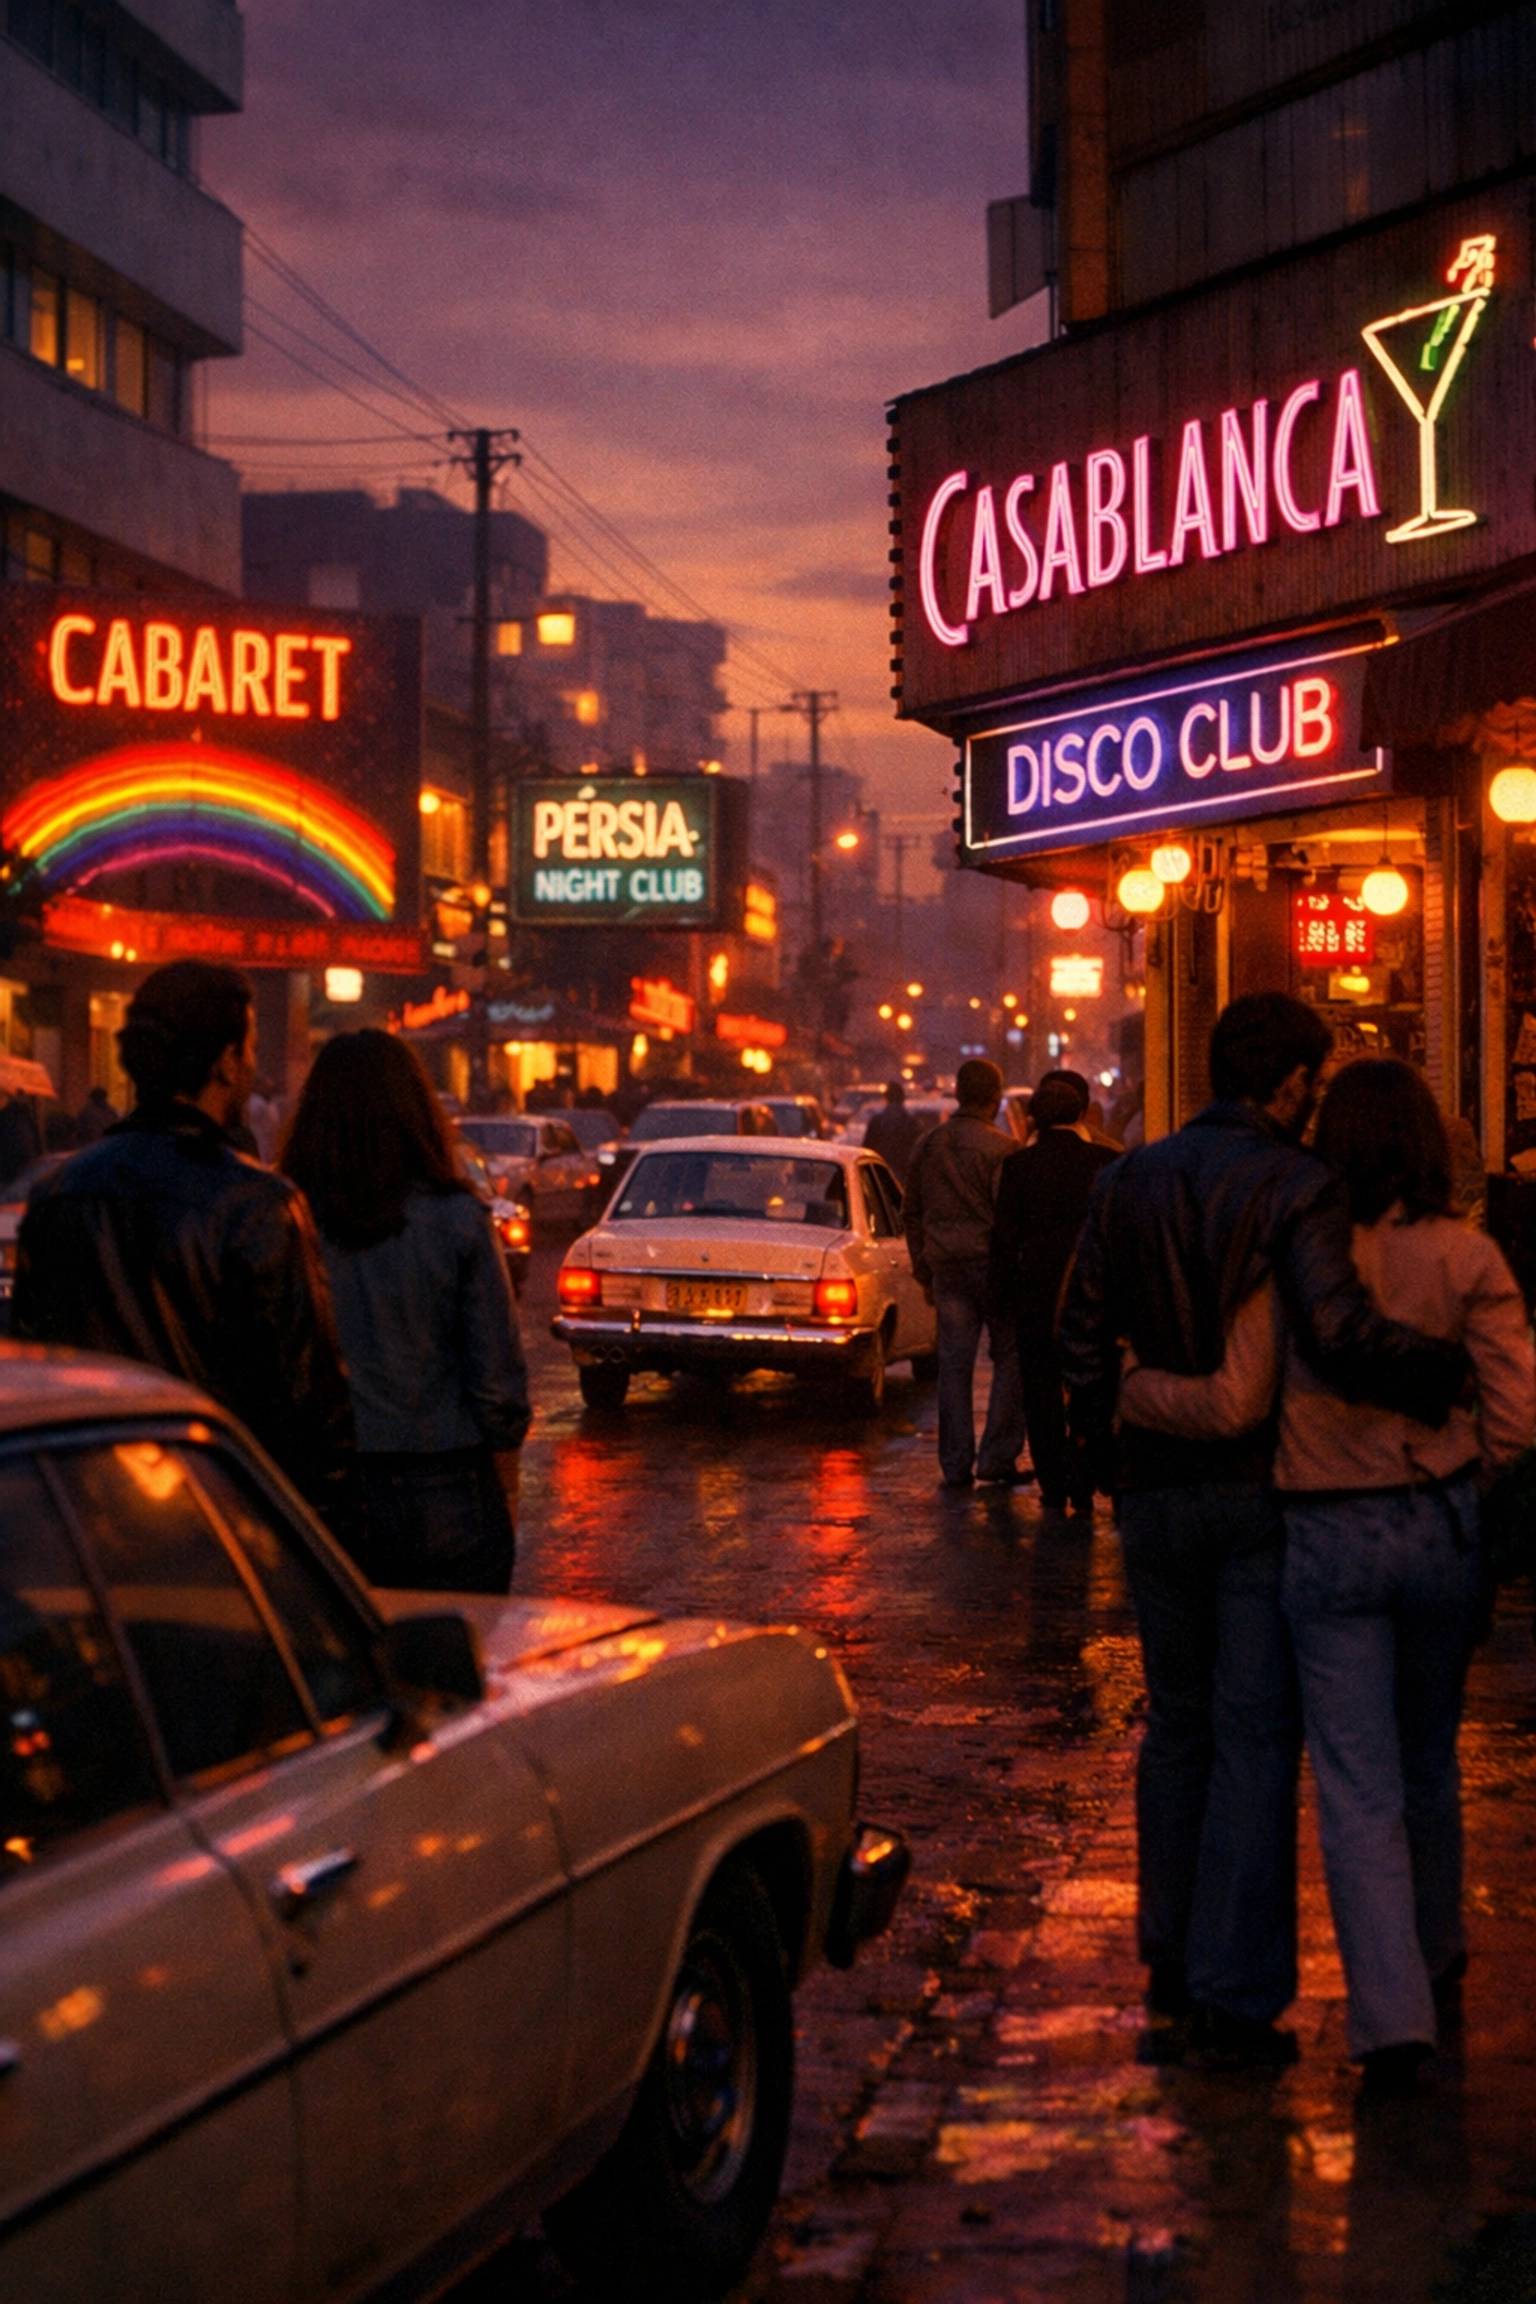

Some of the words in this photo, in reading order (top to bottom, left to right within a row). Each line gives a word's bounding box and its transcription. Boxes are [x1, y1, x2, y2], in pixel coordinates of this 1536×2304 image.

[919, 369, 1381, 645] CASABLANCA
[49, 614, 351, 721] CABARET
[1006, 716, 1163, 816] DISCO
[1179, 677, 1334, 779] CLUB
[534, 869, 621, 902] NIGHT
[629, 869, 704, 902] CLUB
